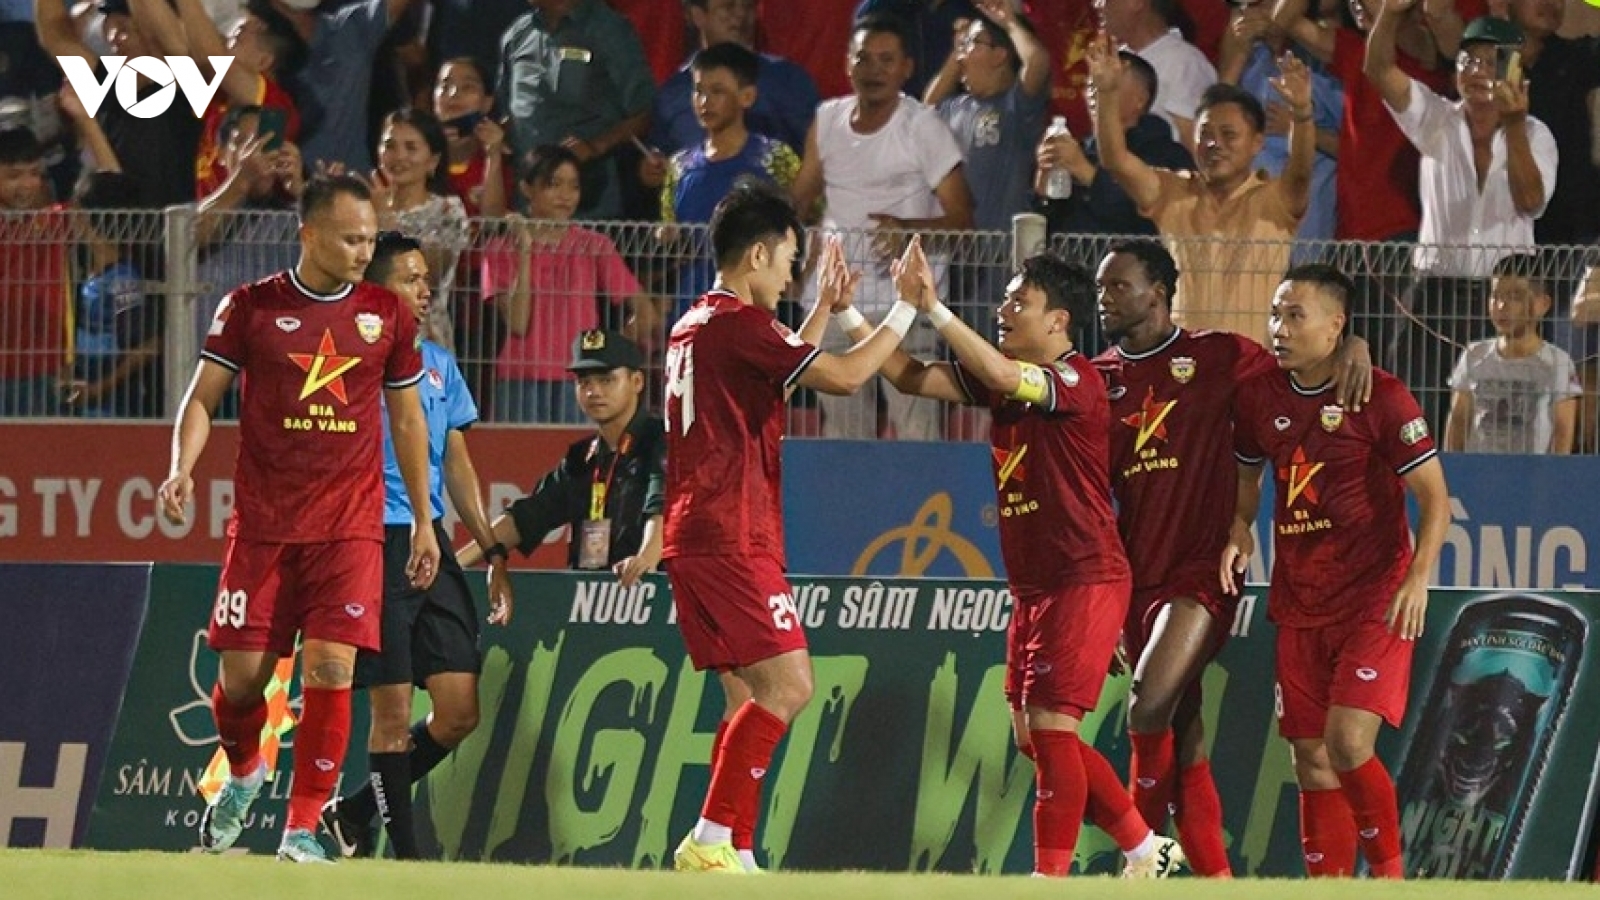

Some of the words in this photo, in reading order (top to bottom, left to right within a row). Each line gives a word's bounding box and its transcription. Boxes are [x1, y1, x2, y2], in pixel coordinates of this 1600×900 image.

[283, 418, 313, 431] SAO
[309, 404, 334, 417] BIA
[33, 478, 102, 539] TY
[214, 588, 248, 629] 89
[837, 581, 919, 629] SÂM
[926, 587, 1013, 638] NGỌC
[114, 759, 171, 797] SÂM
